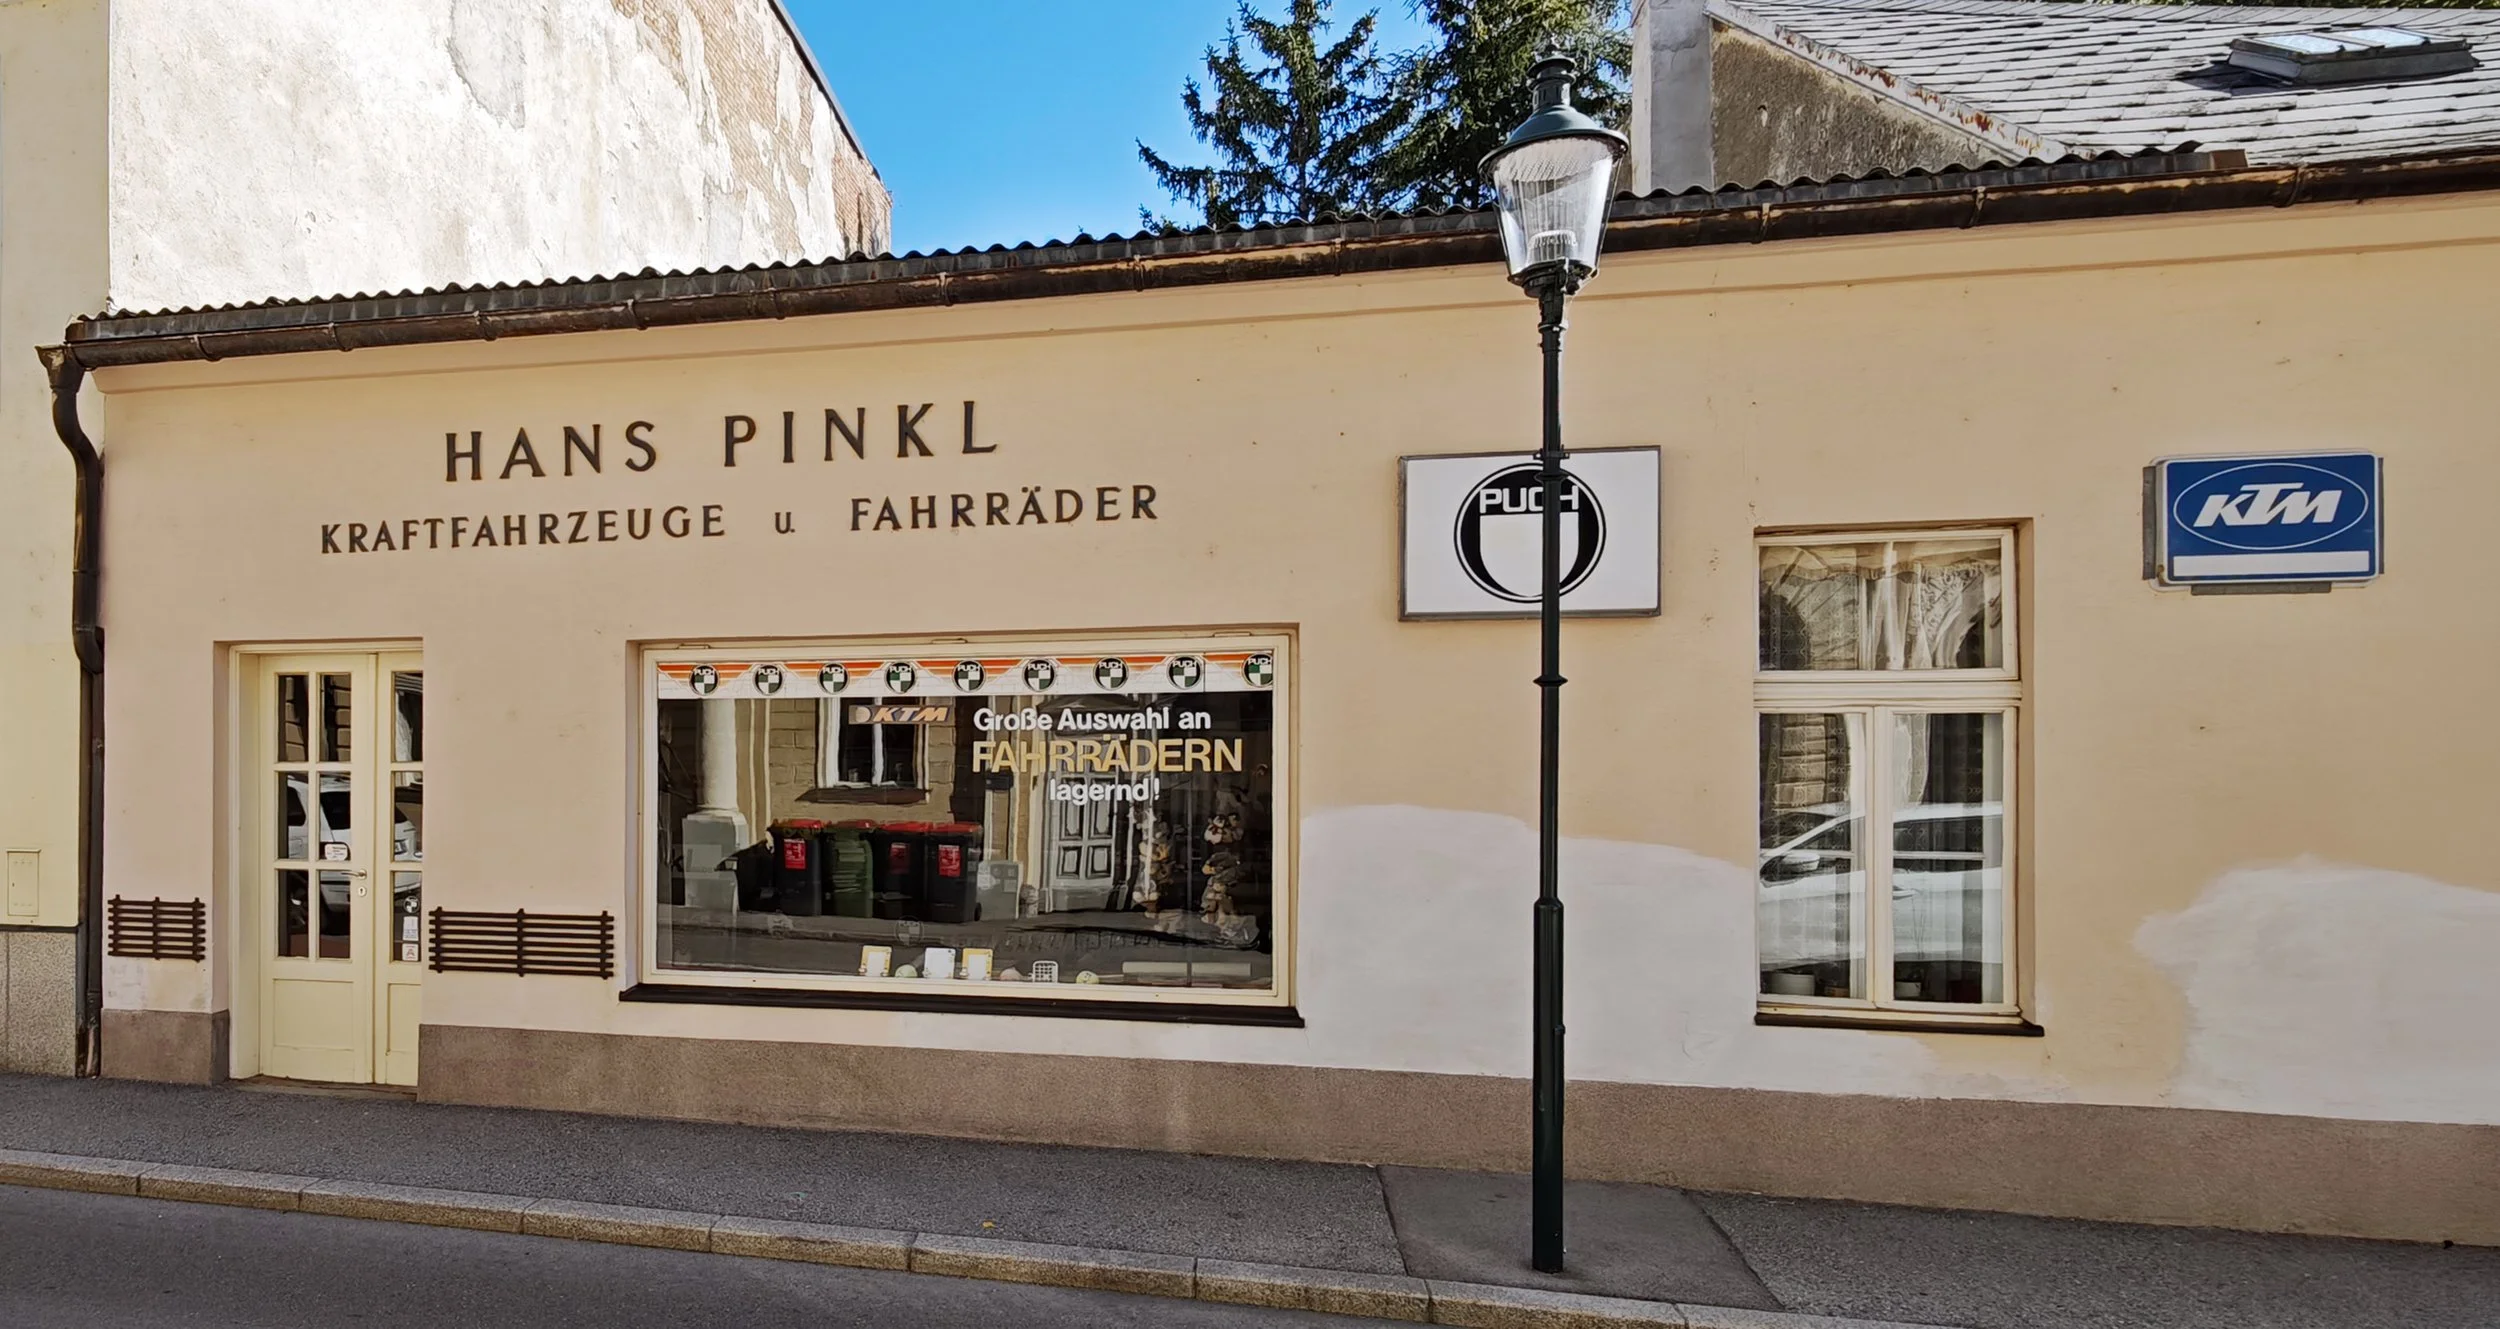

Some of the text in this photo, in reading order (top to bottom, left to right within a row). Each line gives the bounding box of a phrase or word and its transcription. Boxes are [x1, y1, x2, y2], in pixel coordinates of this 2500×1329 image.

[444, 401, 998, 482] HANS PINKL
[1479, 485, 1579, 514] PUCH
[2193, 482, 2342, 527] KTM
[321, 485, 1160, 554] KRAFTFAHRZEUGE u. FAHRRÄDER
[872, 706, 949, 722] KTM
[973, 706, 1212, 732] Große Auswahl an
[972, 734, 1243, 773] FAHRRÄDERN
[1049, 778, 1160, 806] lagernd!
